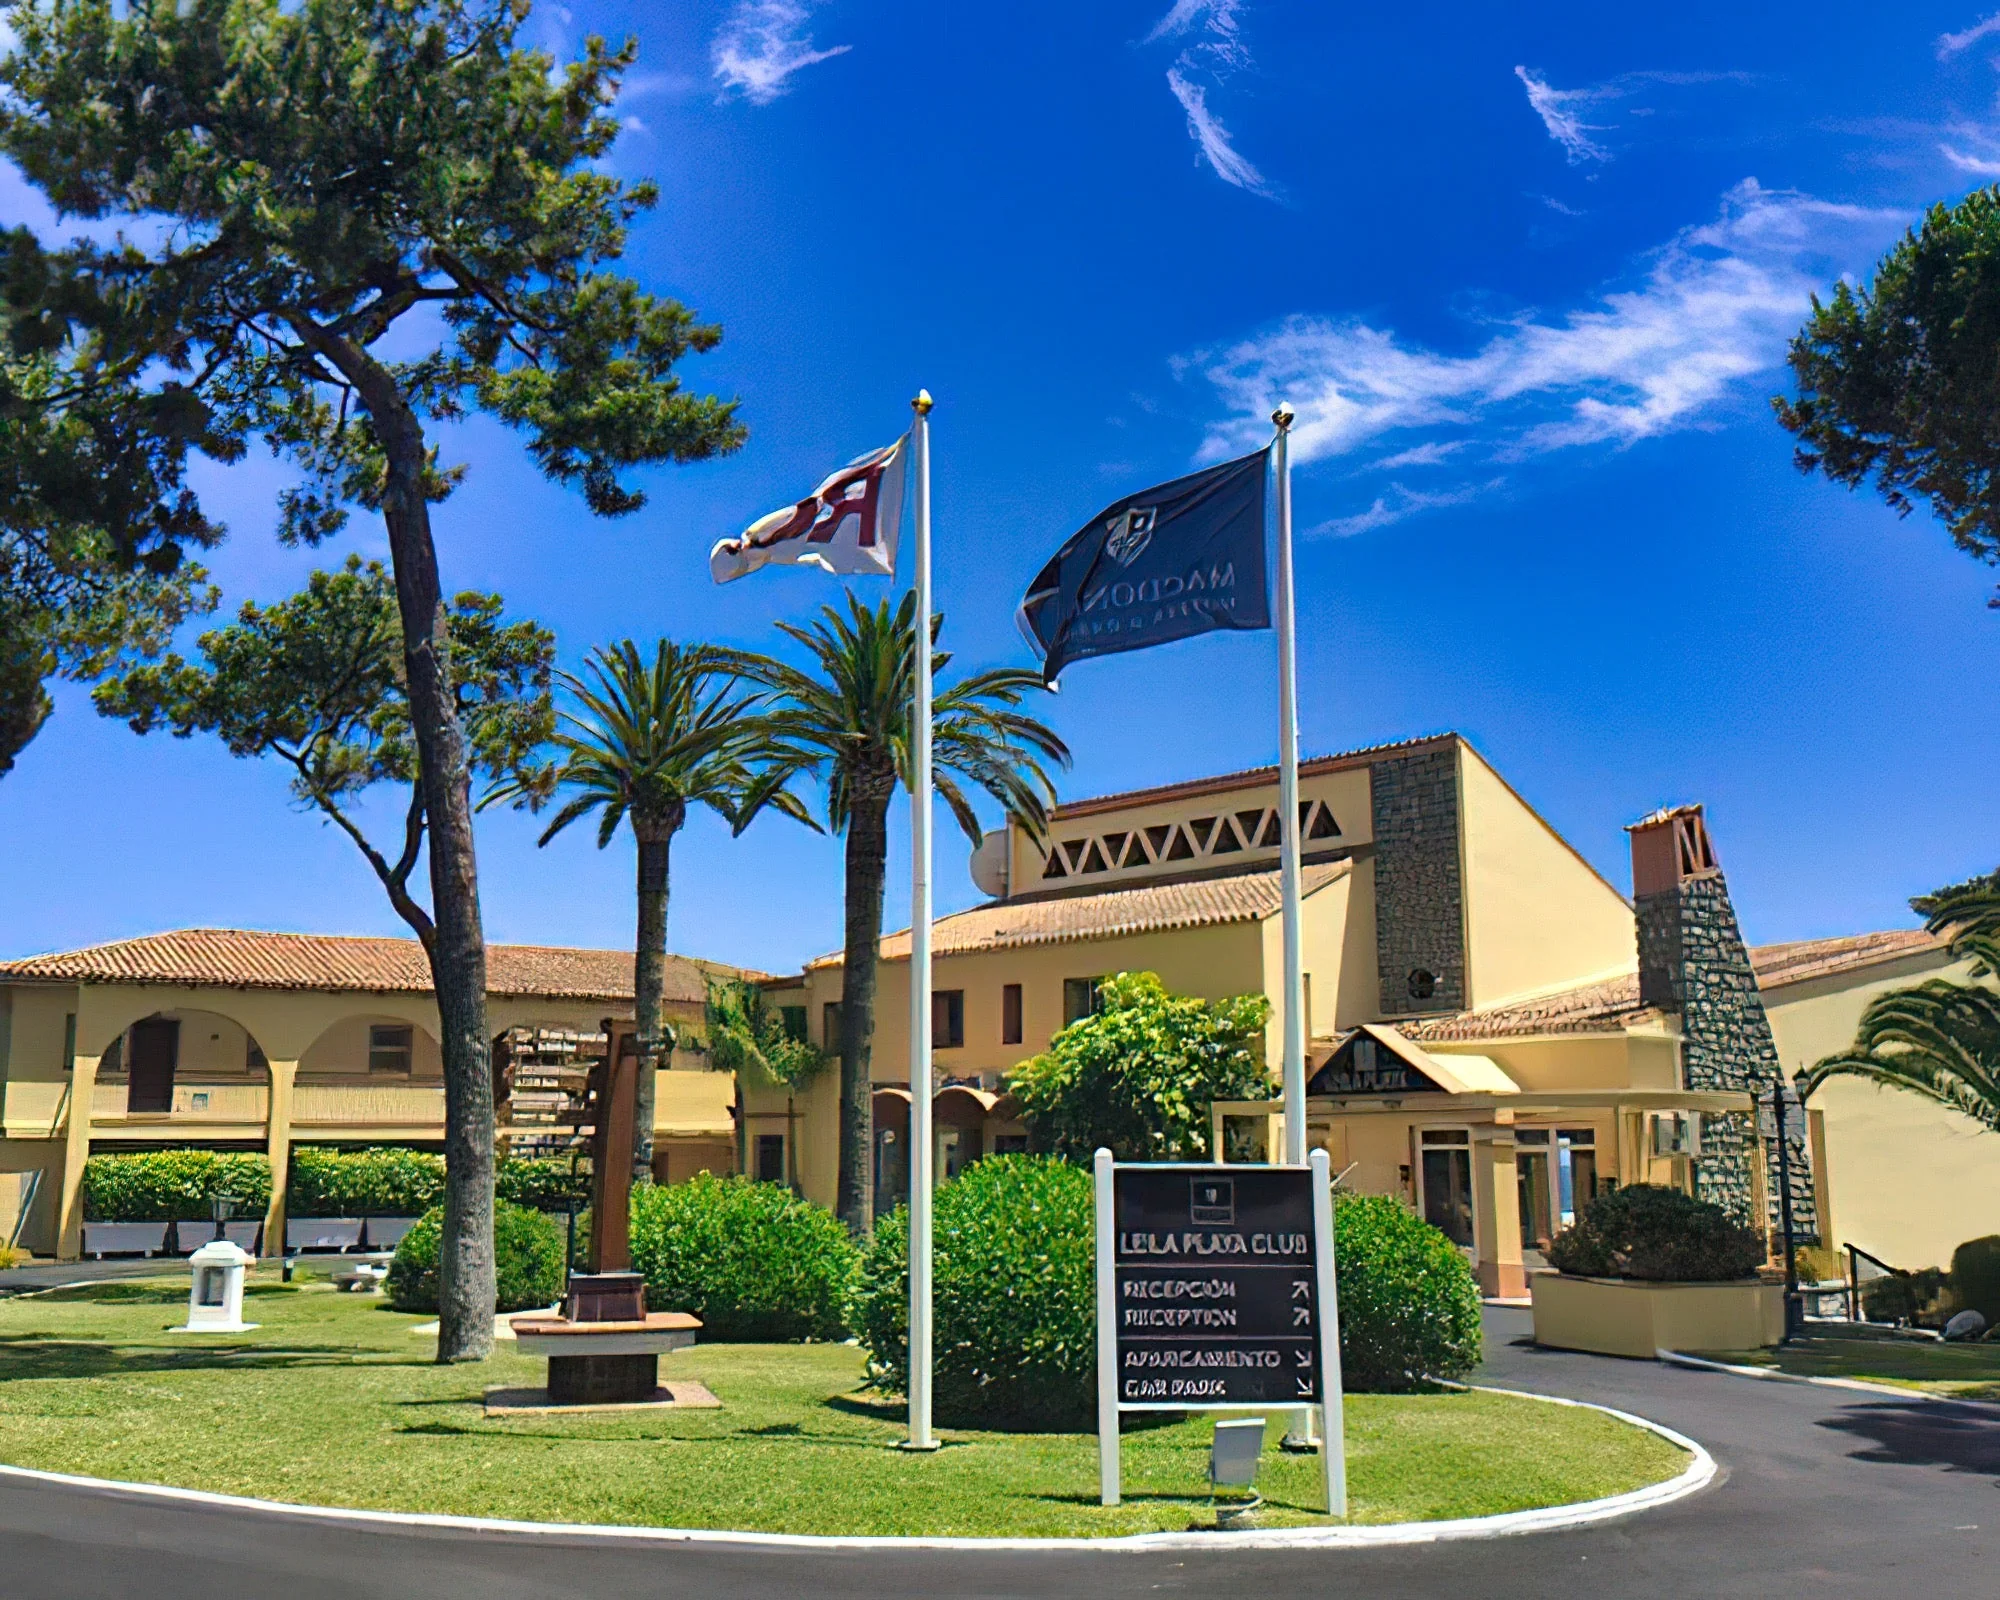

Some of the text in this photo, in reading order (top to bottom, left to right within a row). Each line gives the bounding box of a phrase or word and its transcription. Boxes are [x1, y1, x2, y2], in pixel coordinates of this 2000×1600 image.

[1251, 1233, 1307, 1254] CLUB
[1124, 1308, 1237, 1326] RECEPTION
[1125, 1379, 1167, 1397] CAR
